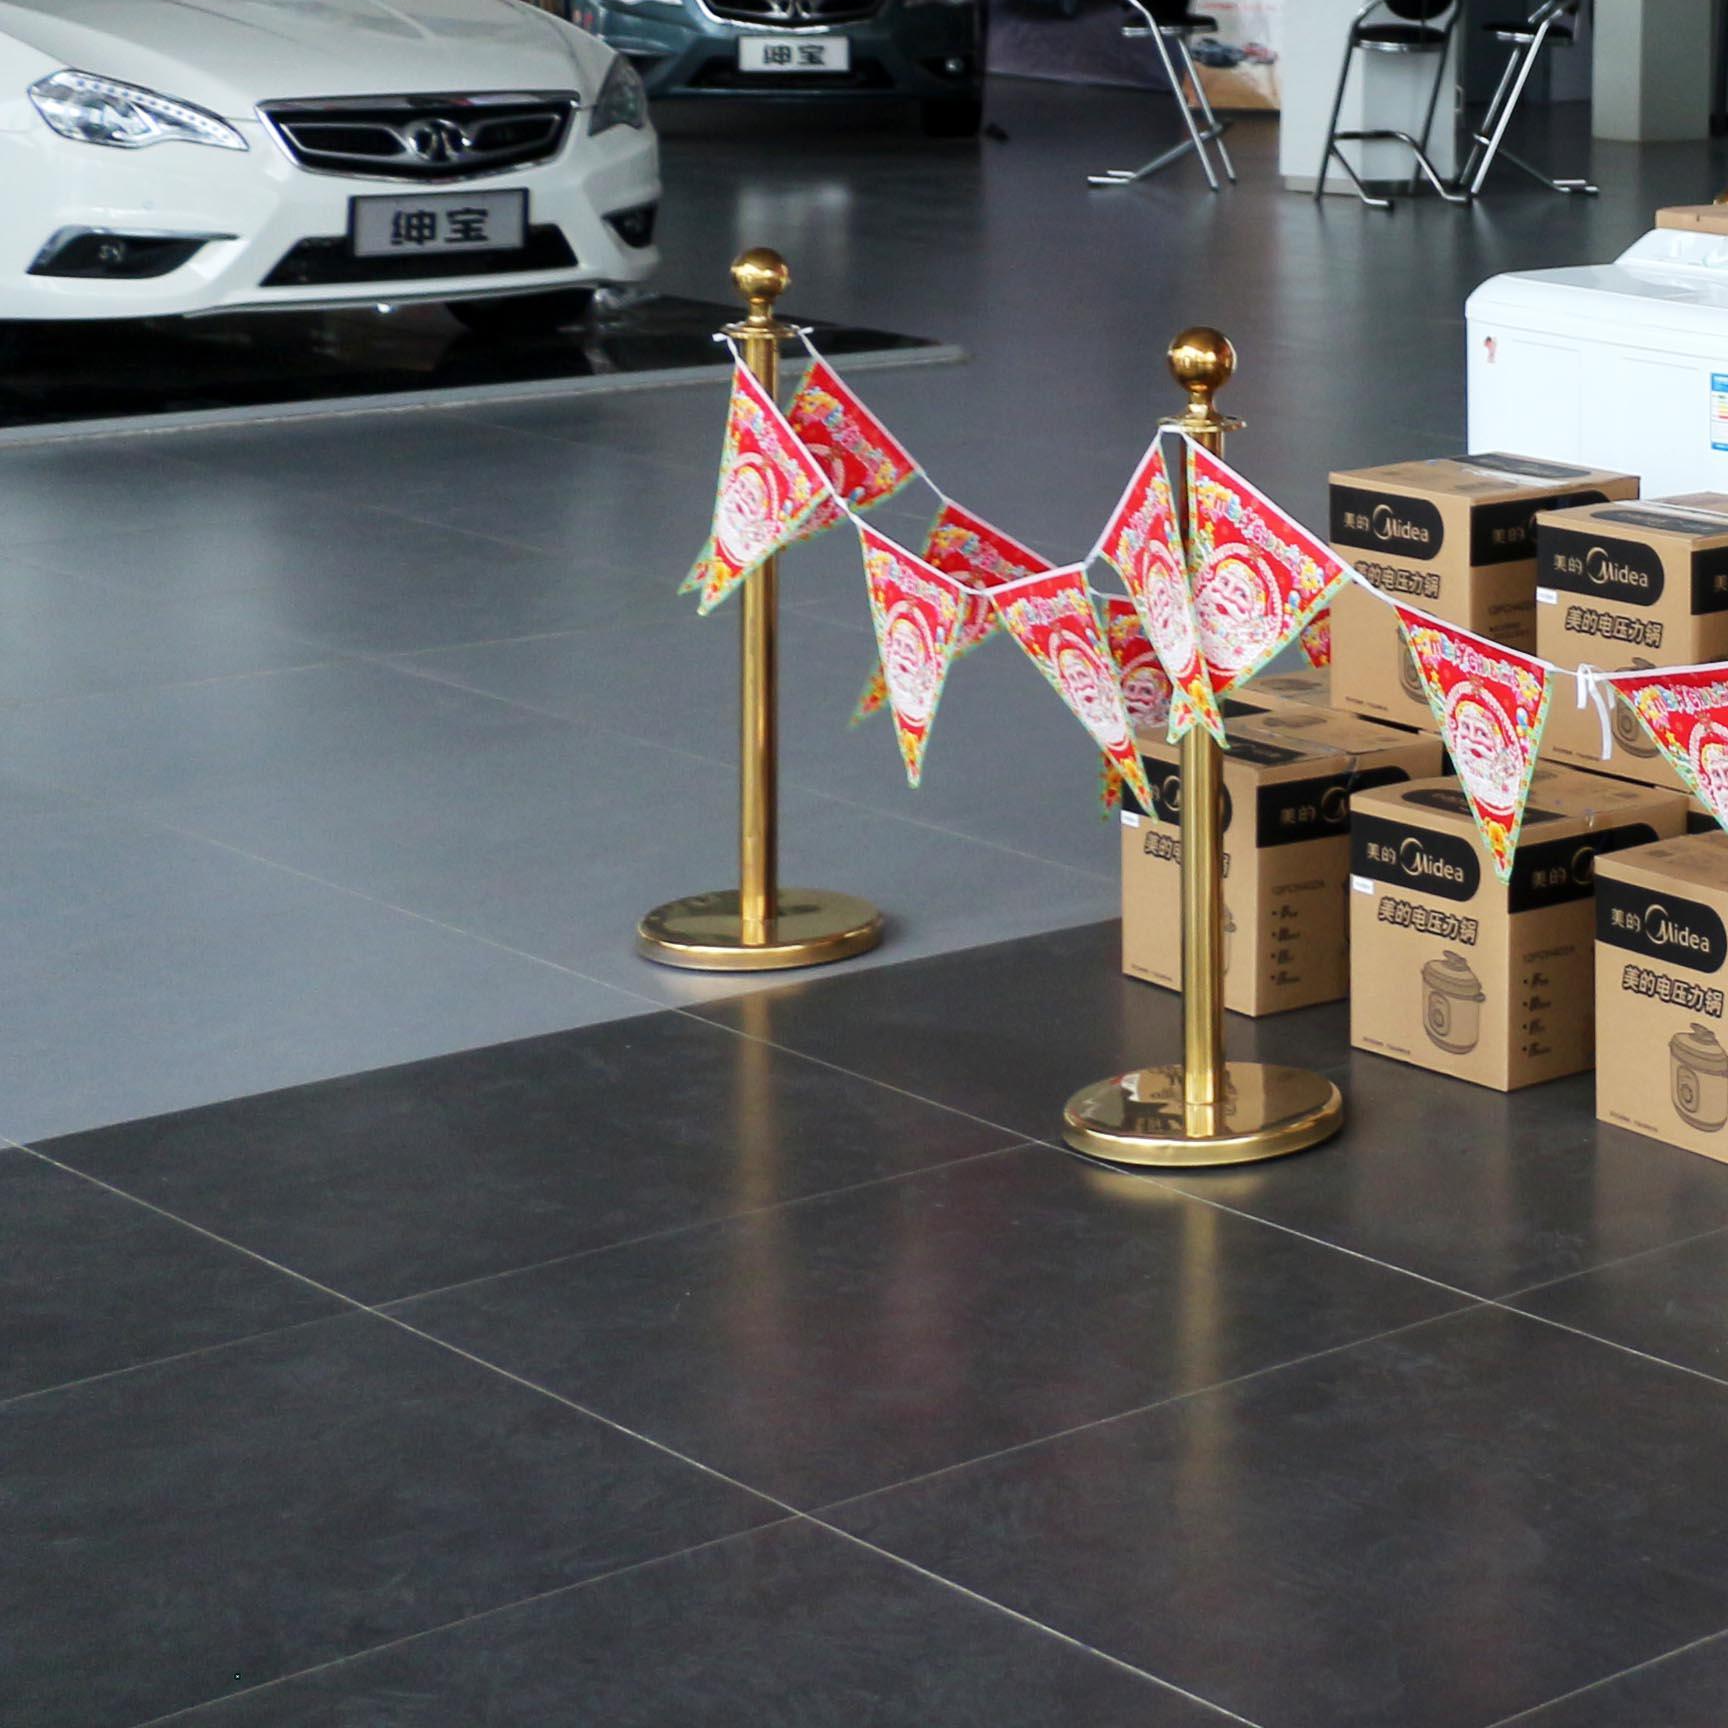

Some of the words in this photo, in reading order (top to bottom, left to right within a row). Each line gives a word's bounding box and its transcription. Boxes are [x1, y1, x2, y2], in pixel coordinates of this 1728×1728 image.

[761, 42, 826, 69] 绅宝
[390, 210, 490, 247] 绅宝
[1343, 512, 1369, 531] 美的
[1372, 504, 1430, 544] Midea
[1552, 555, 1583, 575] 美的
[1587, 545, 1649, 590] Midea
[1564, 606, 1663, 649] 美的电压力锅
[1366, 842, 1396, 864] 美的
[1400, 836, 1464, 885] Midea
[1377, 896, 1479, 946] 美的电压力锅
[1610, 907, 1640, 930] 美的
[1644, 902, 1711, 954] Midea
[1621, 964, 1725, 1018] 美的电压力锅
